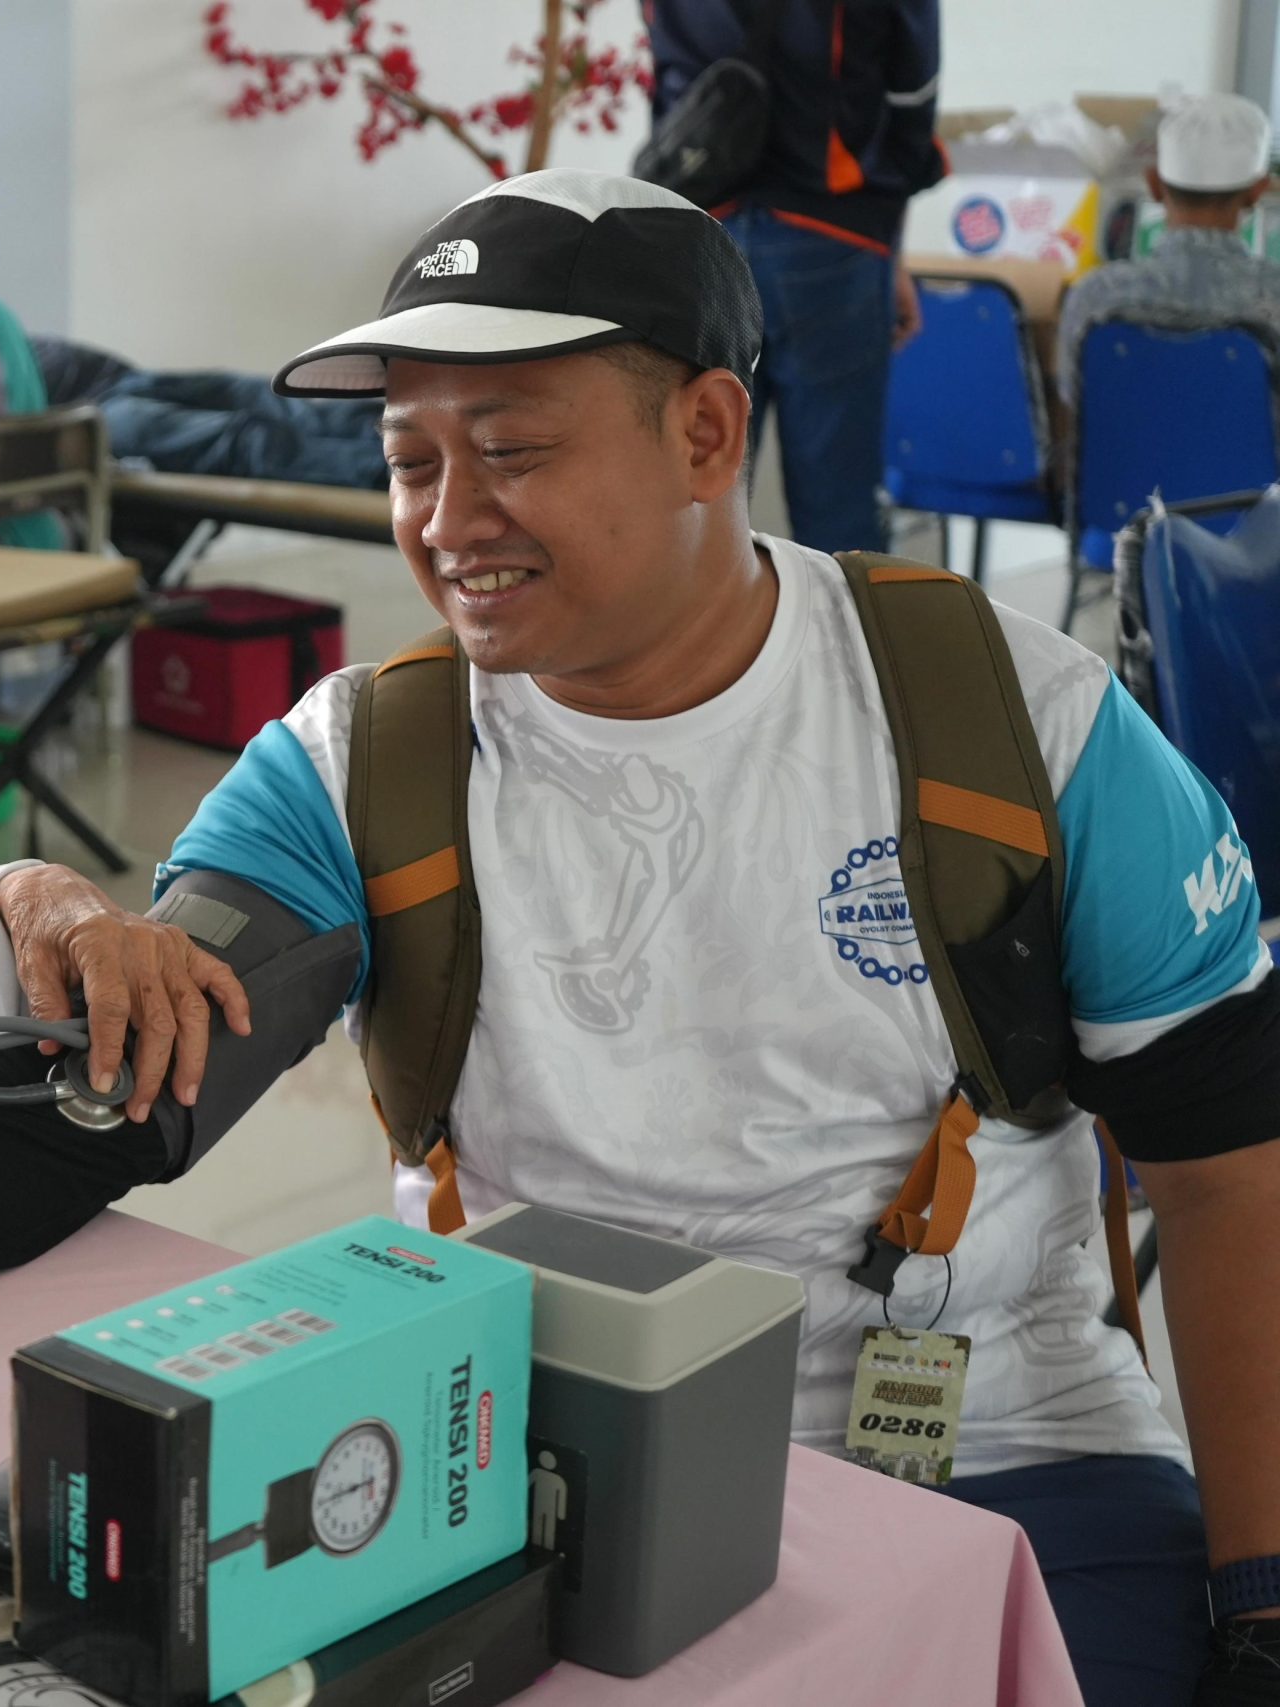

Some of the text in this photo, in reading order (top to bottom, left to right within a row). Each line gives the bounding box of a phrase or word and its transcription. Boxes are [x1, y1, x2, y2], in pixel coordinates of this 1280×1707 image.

[436, 240, 461, 254] THE
[414, 250, 457, 271] NORTH
[420, 262, 453, 279] FACE
[836, 901, 912, 923] RAILW
[343, 1242, 406, 1269] TENSI
[401, 1264, 447, 1284] 200
[859, 1412, 947, 1439] 0286
[447, 1353, 471, 1529] TENSI 200
[67, 1471, 88, 1600] TENSI 200
